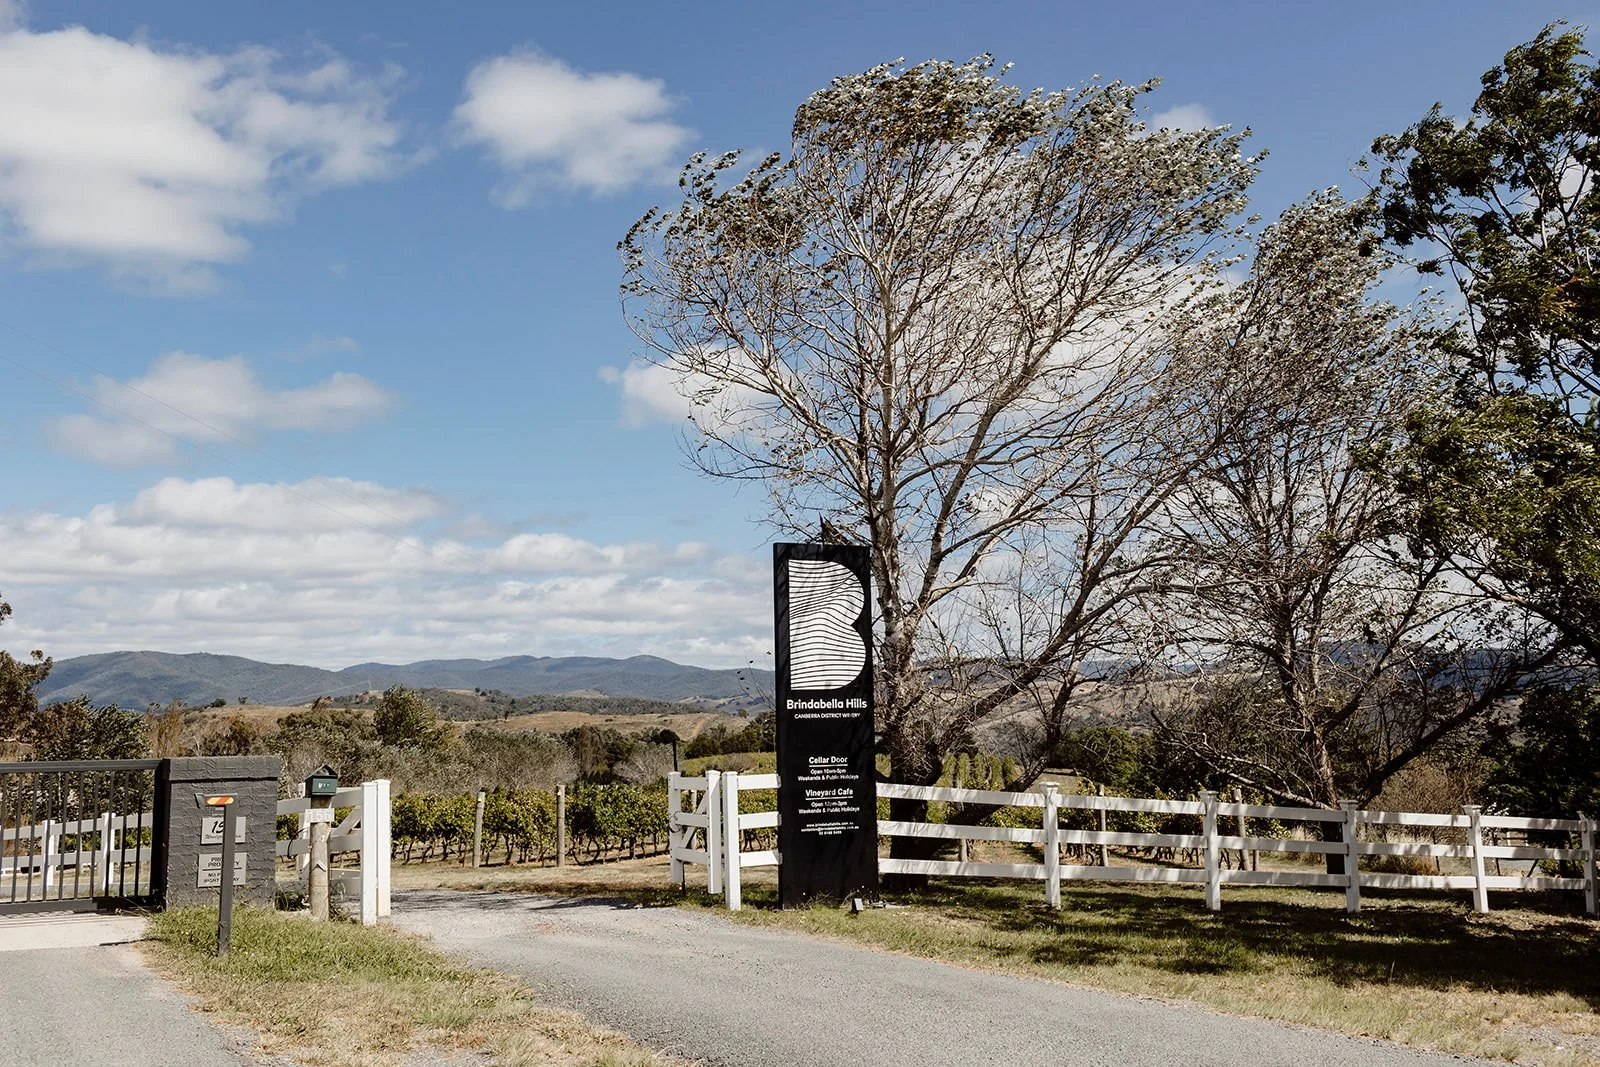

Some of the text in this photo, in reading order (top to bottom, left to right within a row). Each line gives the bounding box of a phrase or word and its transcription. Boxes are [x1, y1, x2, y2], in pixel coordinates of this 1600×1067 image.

[786, 699, 868, 709] Brindabella Hills
[809, 756, 830, 764] Cellar
[806, 789, 836, 798] Vineyard
